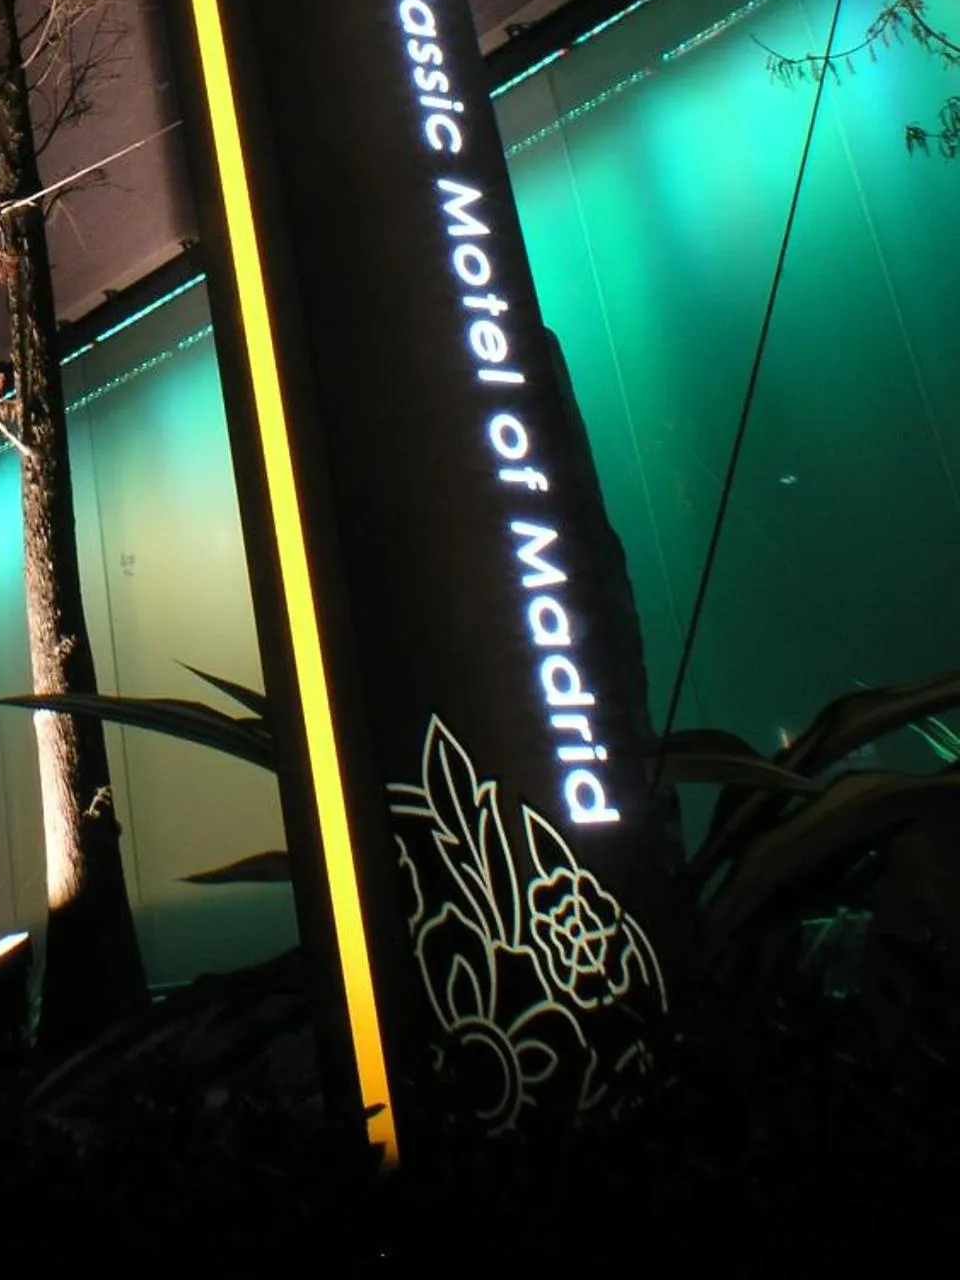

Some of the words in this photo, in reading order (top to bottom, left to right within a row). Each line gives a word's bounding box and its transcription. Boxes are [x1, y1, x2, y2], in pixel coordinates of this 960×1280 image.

[436, 178, 526, 385] Motel
[487, 412, 549, 493] of
[510, 520, 622, 825] Madrid
